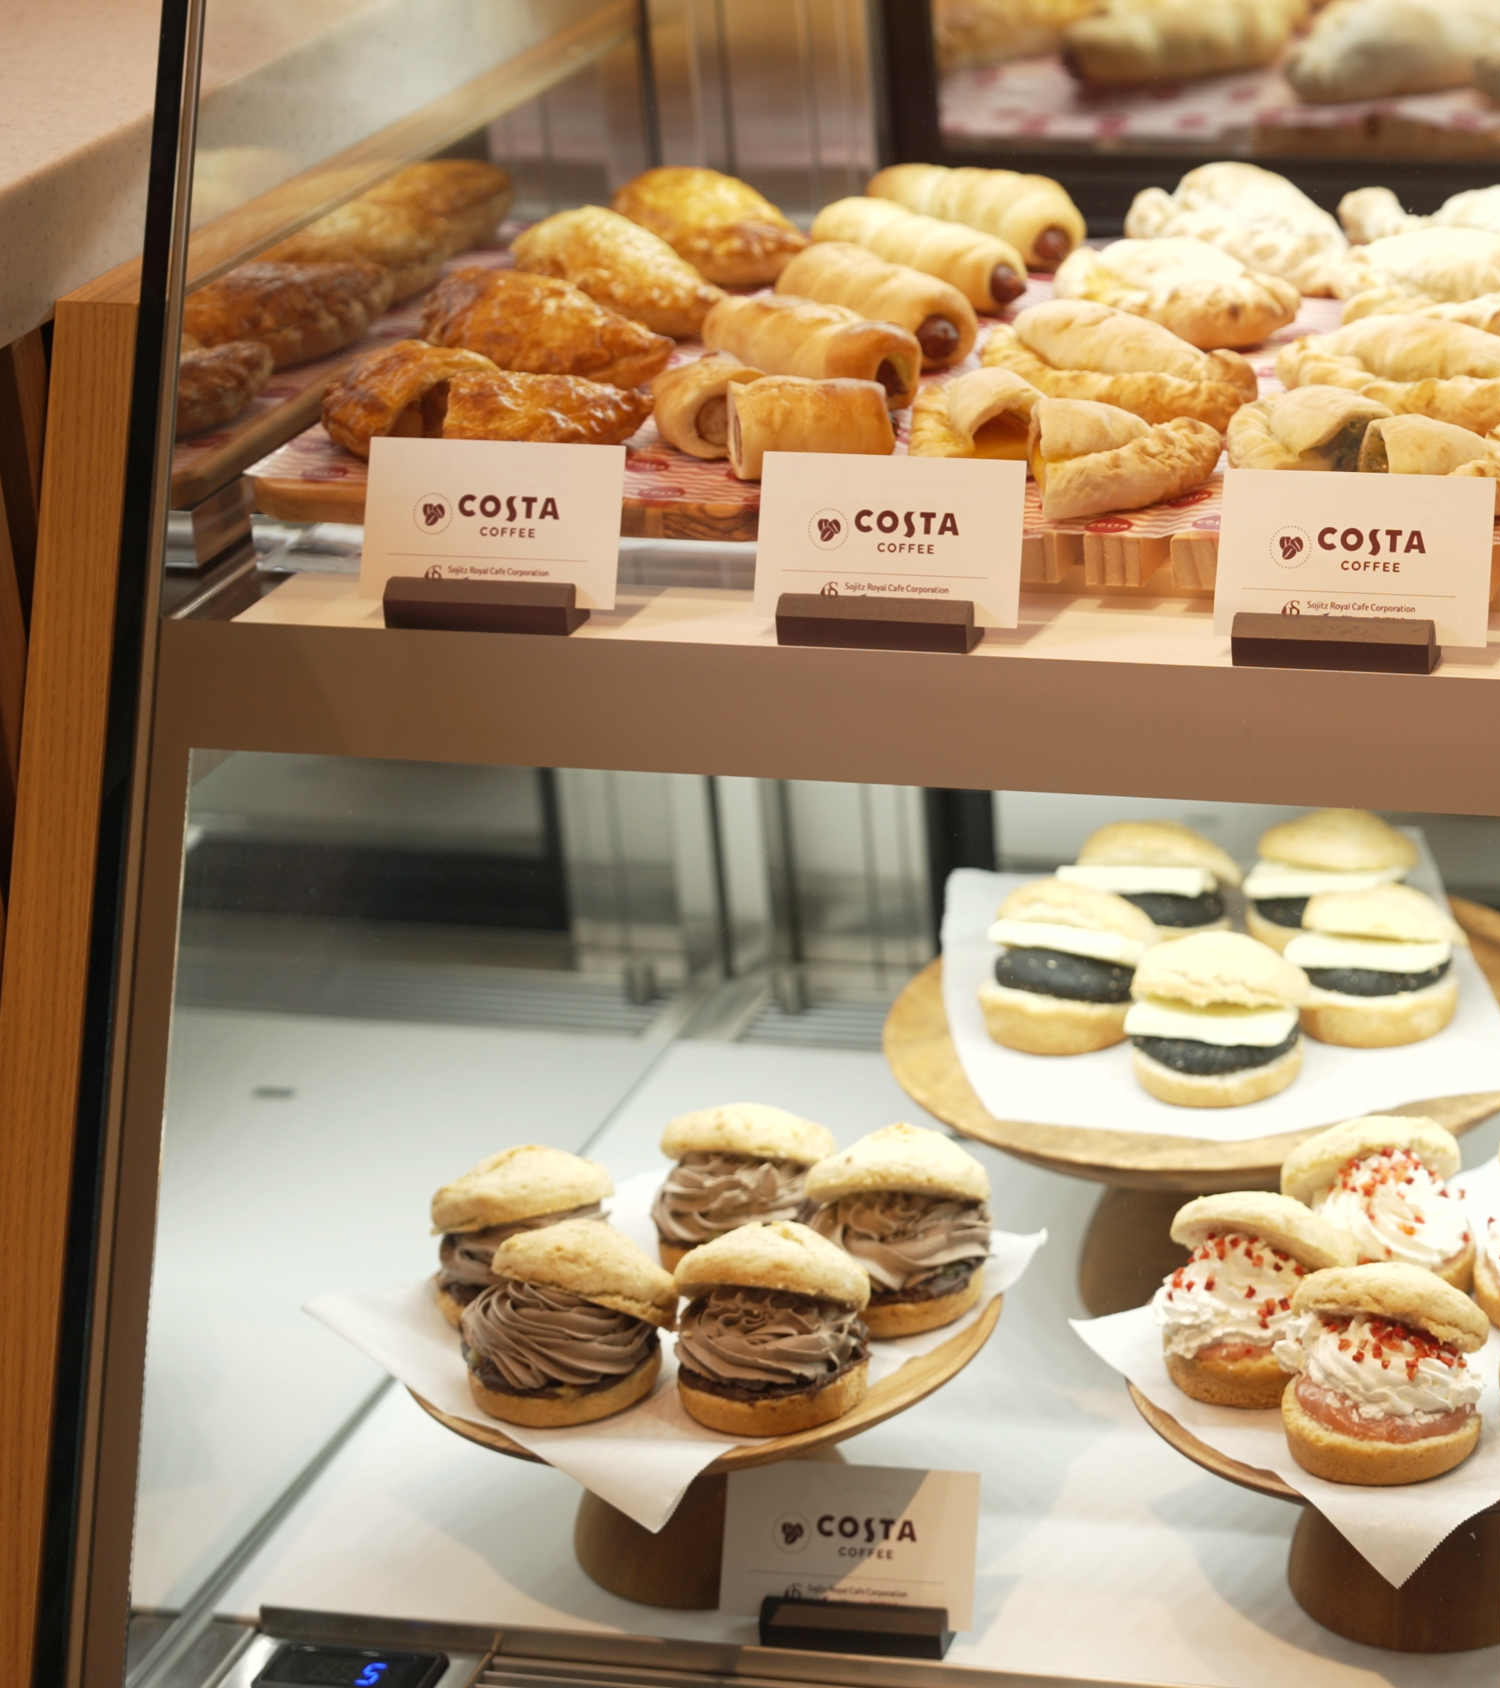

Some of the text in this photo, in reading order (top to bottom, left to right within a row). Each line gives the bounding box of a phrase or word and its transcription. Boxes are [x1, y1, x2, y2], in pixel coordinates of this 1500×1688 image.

[458, 494, 560, 522] COSTA
[855, 509, 959, 538] COSTA
[480, 527, 536, 538] COFFEE
[877, 542, 935, 554] COFFEE
[1318, 526, 1426, 556] COSTA
[448, 565, 468, 575] Sojitz
[470, 566, 489, 576] Royal
[490, 567, 508, 576] Cafe
[509, 568, 549, 578] Corporation
[1341, 560, 1400, 572] COFFEE
[844, 582, 865, 592] Sojitz
[867, 583, 887, 593] Royal
[888, 584, 905, 593] Cafe
[906, 585, 949, 596] Corporation
[1307, 601, 1328, 611] Sojitz
[1330, 602, 1351, 612] Royal
[1352, 602, 1370, 611] Cafe
[1370, 604, 1415, 614] Corporation
[817, 1514, 917, 1543] COSTA
[838, 1546, 894, 1560] COFFEE
